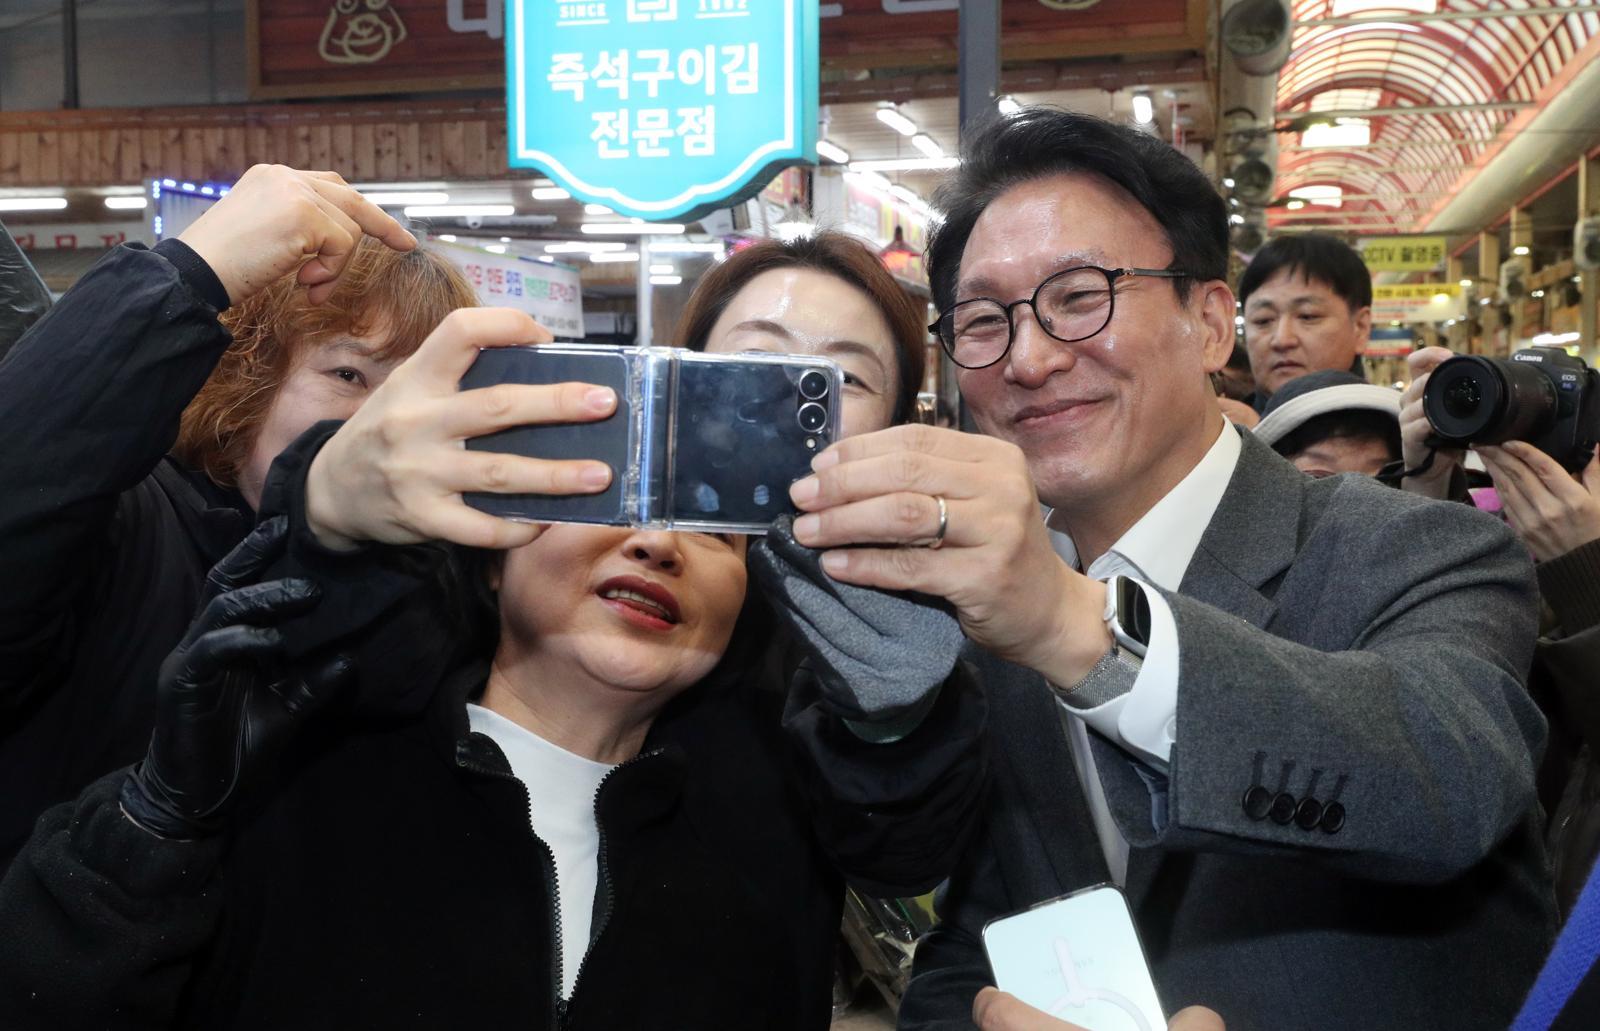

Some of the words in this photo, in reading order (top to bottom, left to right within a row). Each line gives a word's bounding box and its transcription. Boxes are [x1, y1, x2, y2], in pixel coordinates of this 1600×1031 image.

[547, 42, 759, 102] 즉석구이김
[589, 104, 716, 159] 전문점
[1514, 353, 1543, 363] Canon
[1561, 374, 1577, 382] EOS
